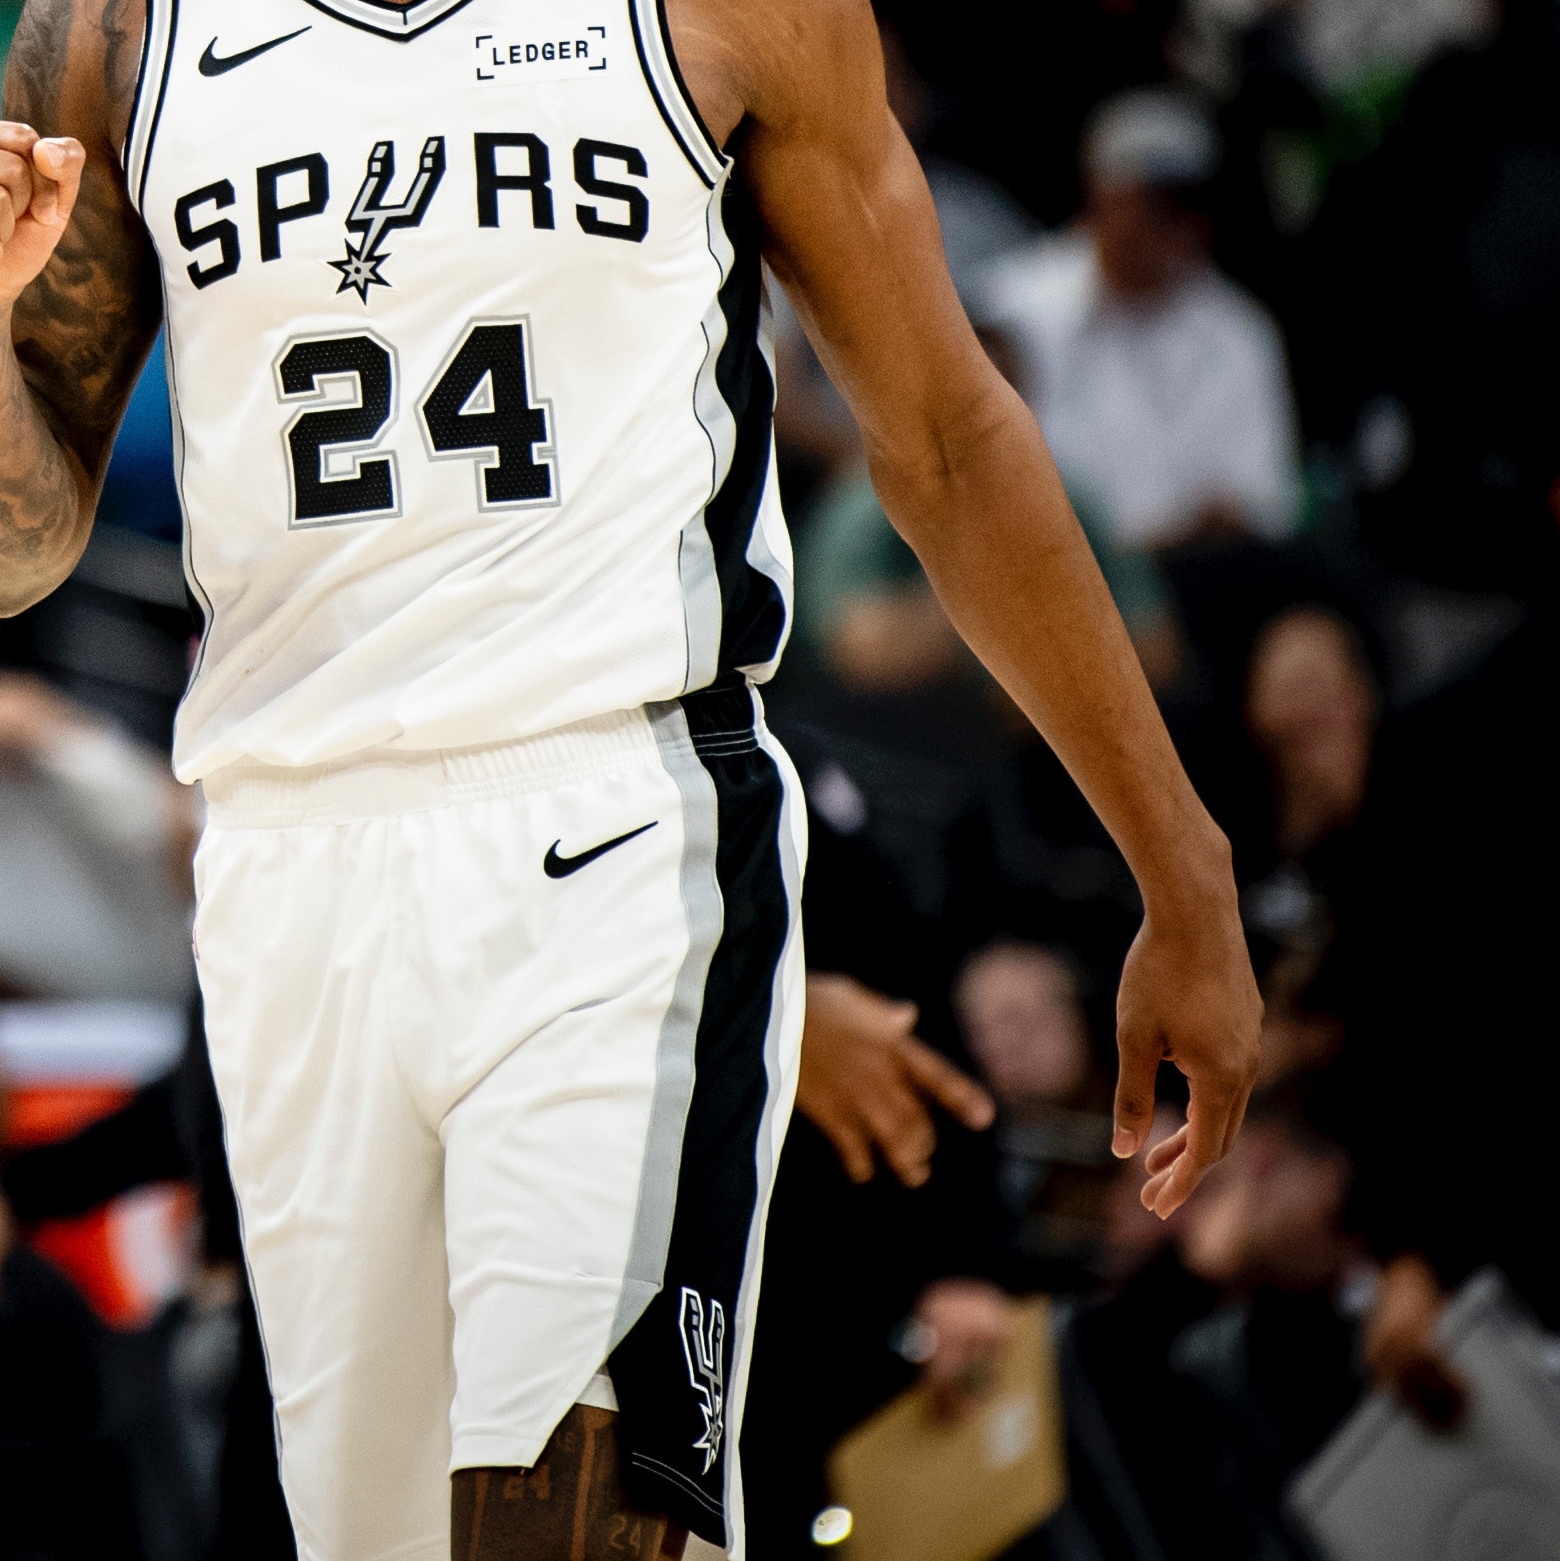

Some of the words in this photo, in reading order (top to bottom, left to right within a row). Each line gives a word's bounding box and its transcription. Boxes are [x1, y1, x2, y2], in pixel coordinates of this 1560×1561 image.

[492, 40, 589, 66] LEDGER
[174, 132, 650, 305] SPURS
[271, 313, 562, 530] 24
